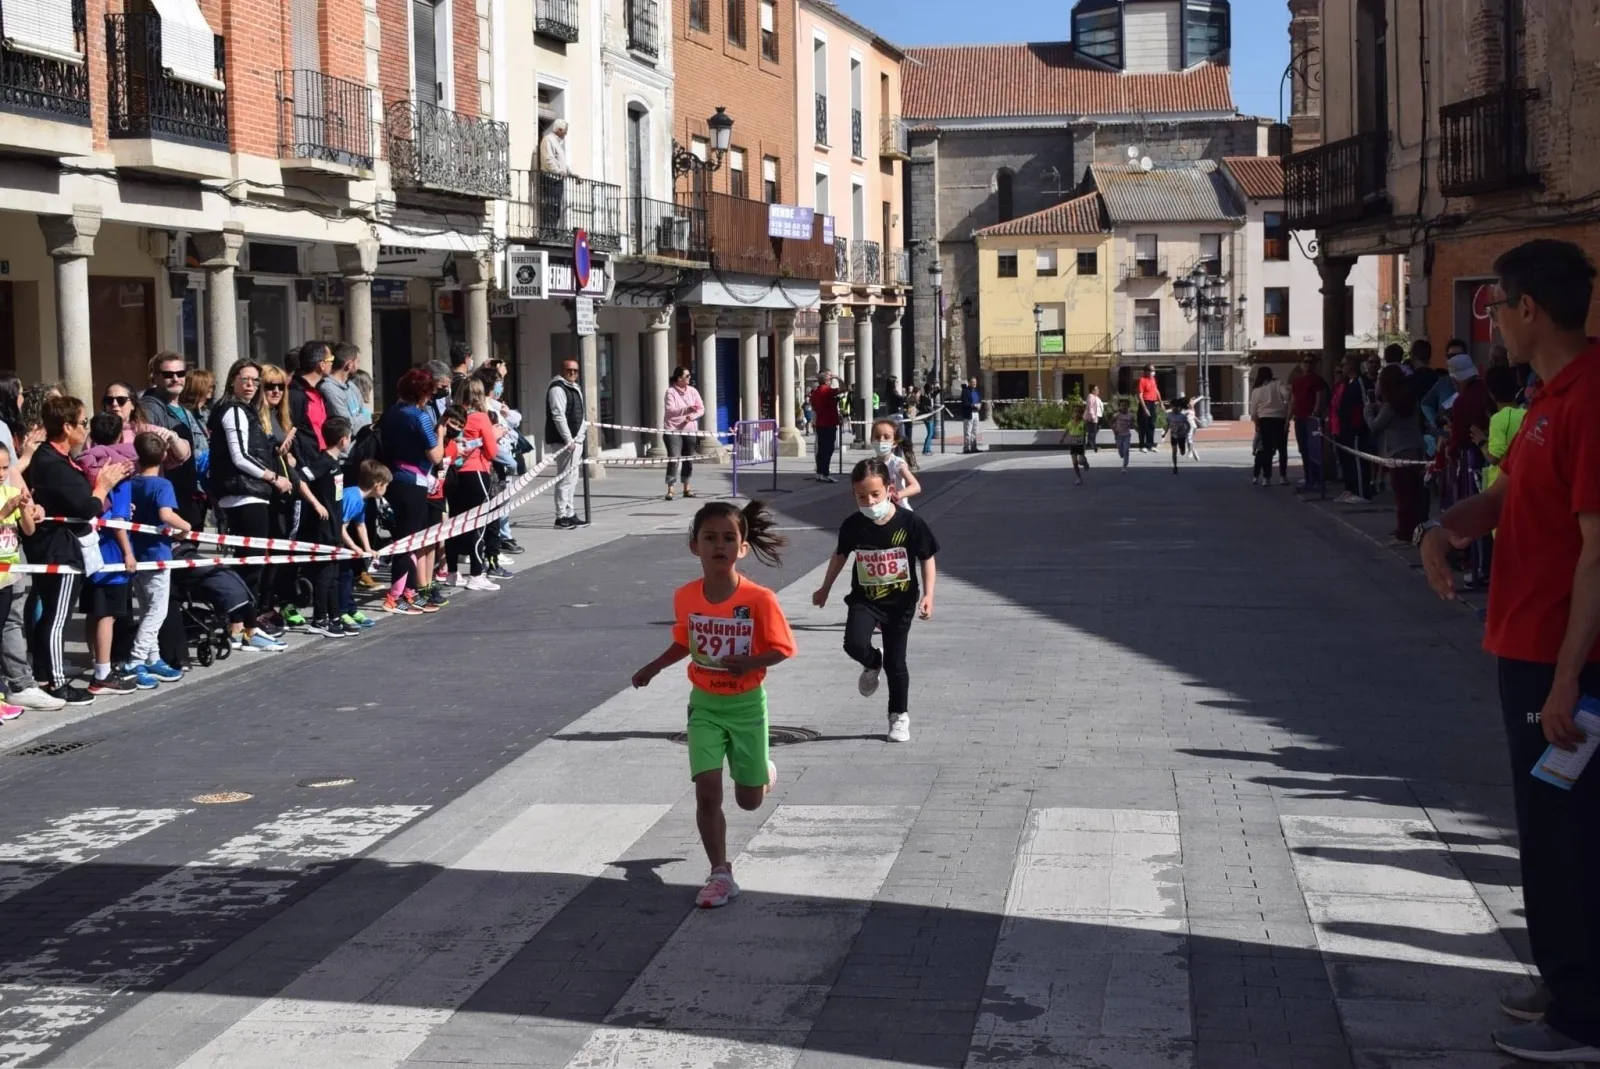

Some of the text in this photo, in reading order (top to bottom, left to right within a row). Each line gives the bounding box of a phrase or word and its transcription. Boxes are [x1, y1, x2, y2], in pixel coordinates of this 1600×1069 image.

[771, 207, 795, 219] VENDE
[511, 286, 542, 297] CARRERA
[866, 561, 898, 577] 308
[697, 635, 736, 657] 291
